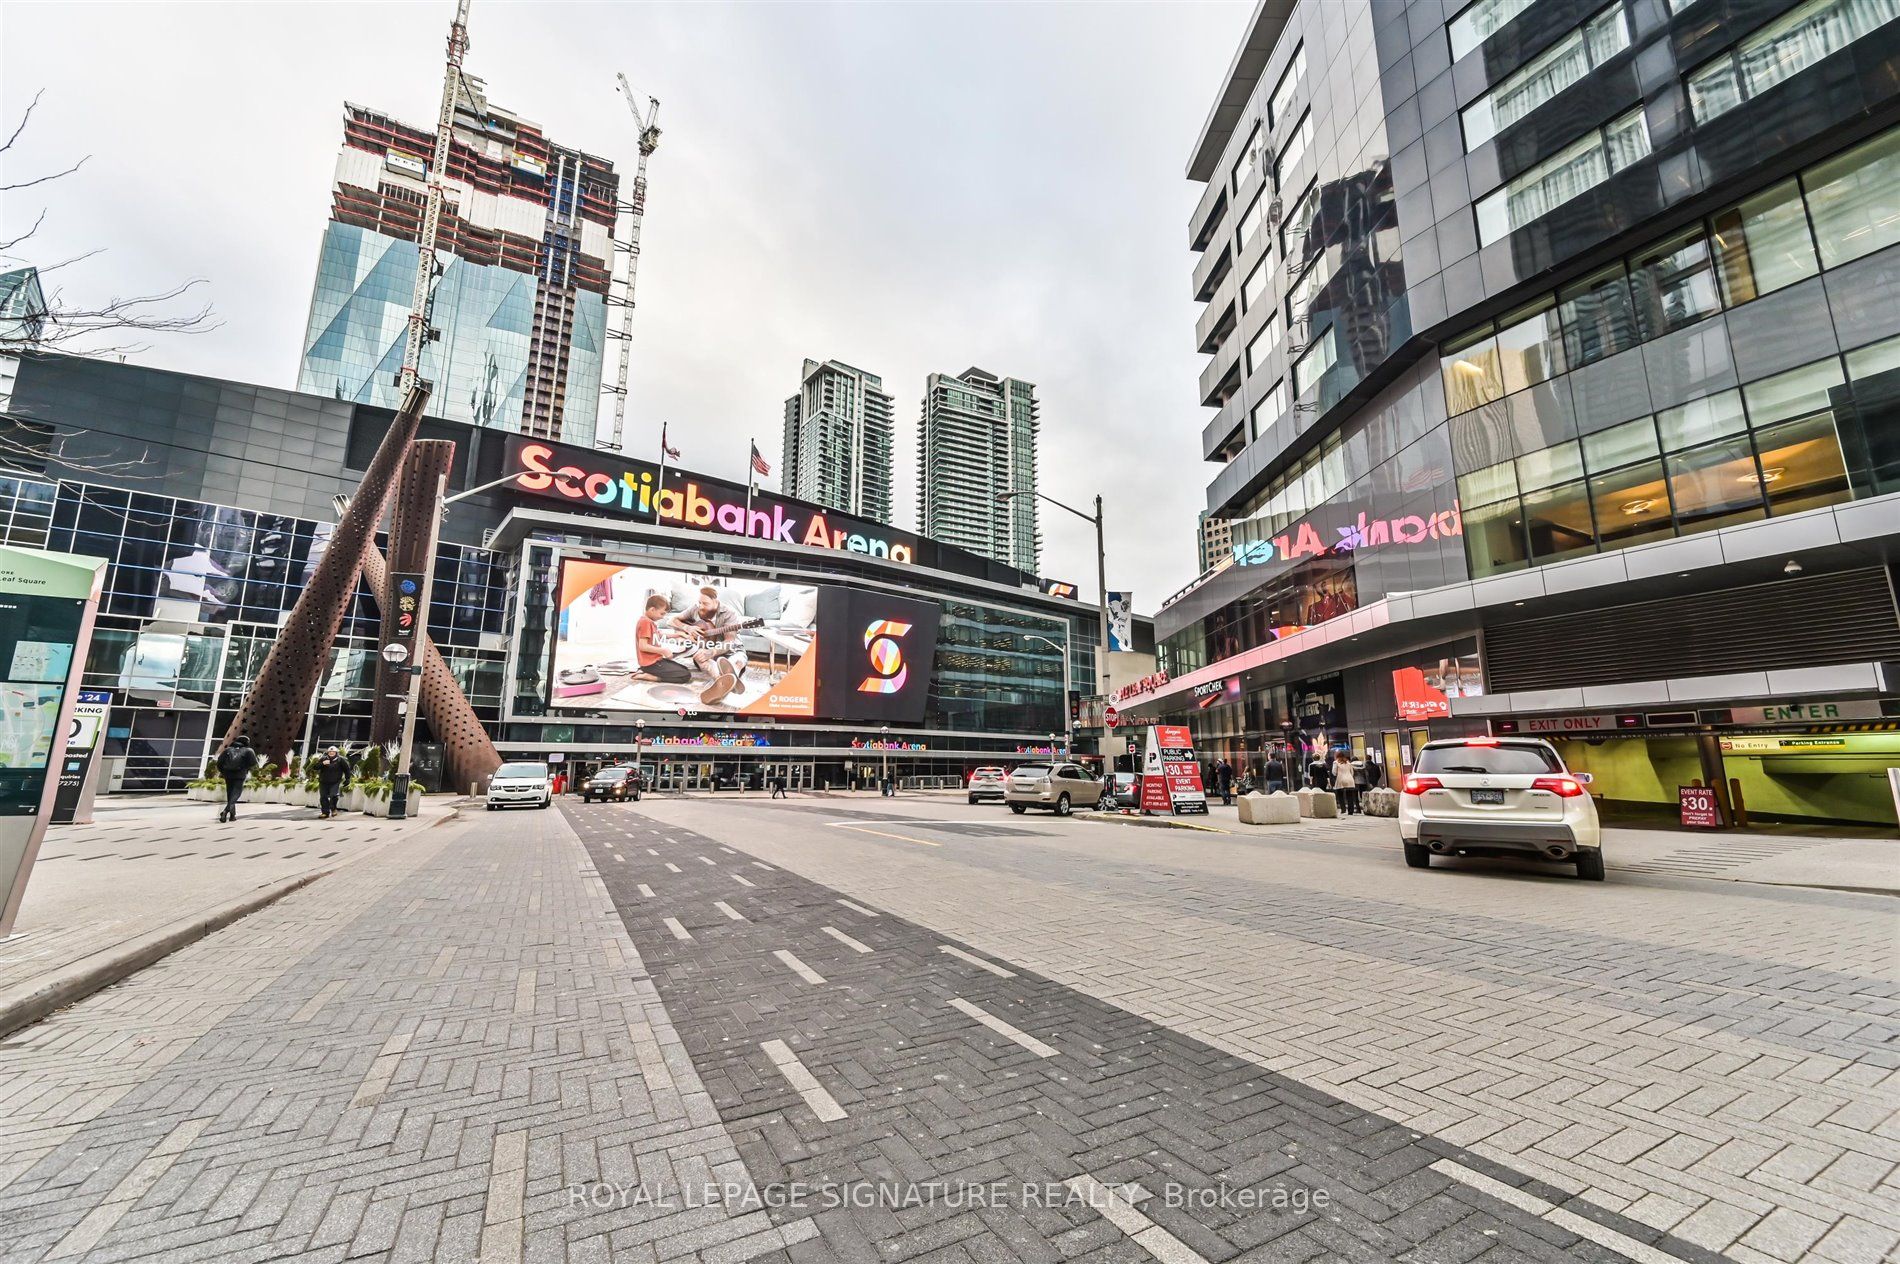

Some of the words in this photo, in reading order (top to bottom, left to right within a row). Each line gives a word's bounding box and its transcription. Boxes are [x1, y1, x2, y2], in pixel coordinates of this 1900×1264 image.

[516, 444, 795, 544] Scotiabank
[803, 514, 911, 565] Arena
[18, 577, 47, 585] Square
[652, 632, 692, 650] More
[1105, 713, 1118, 722] STOP
[1763, 704, 1839, 720] ENTER
[1529, 720, 1558, 731] EXIT
[1563, 717, 1600, 730] ONLY
[851, 739, 900, 750] Scotiabank
[901, 741, 927, 751] Arena
